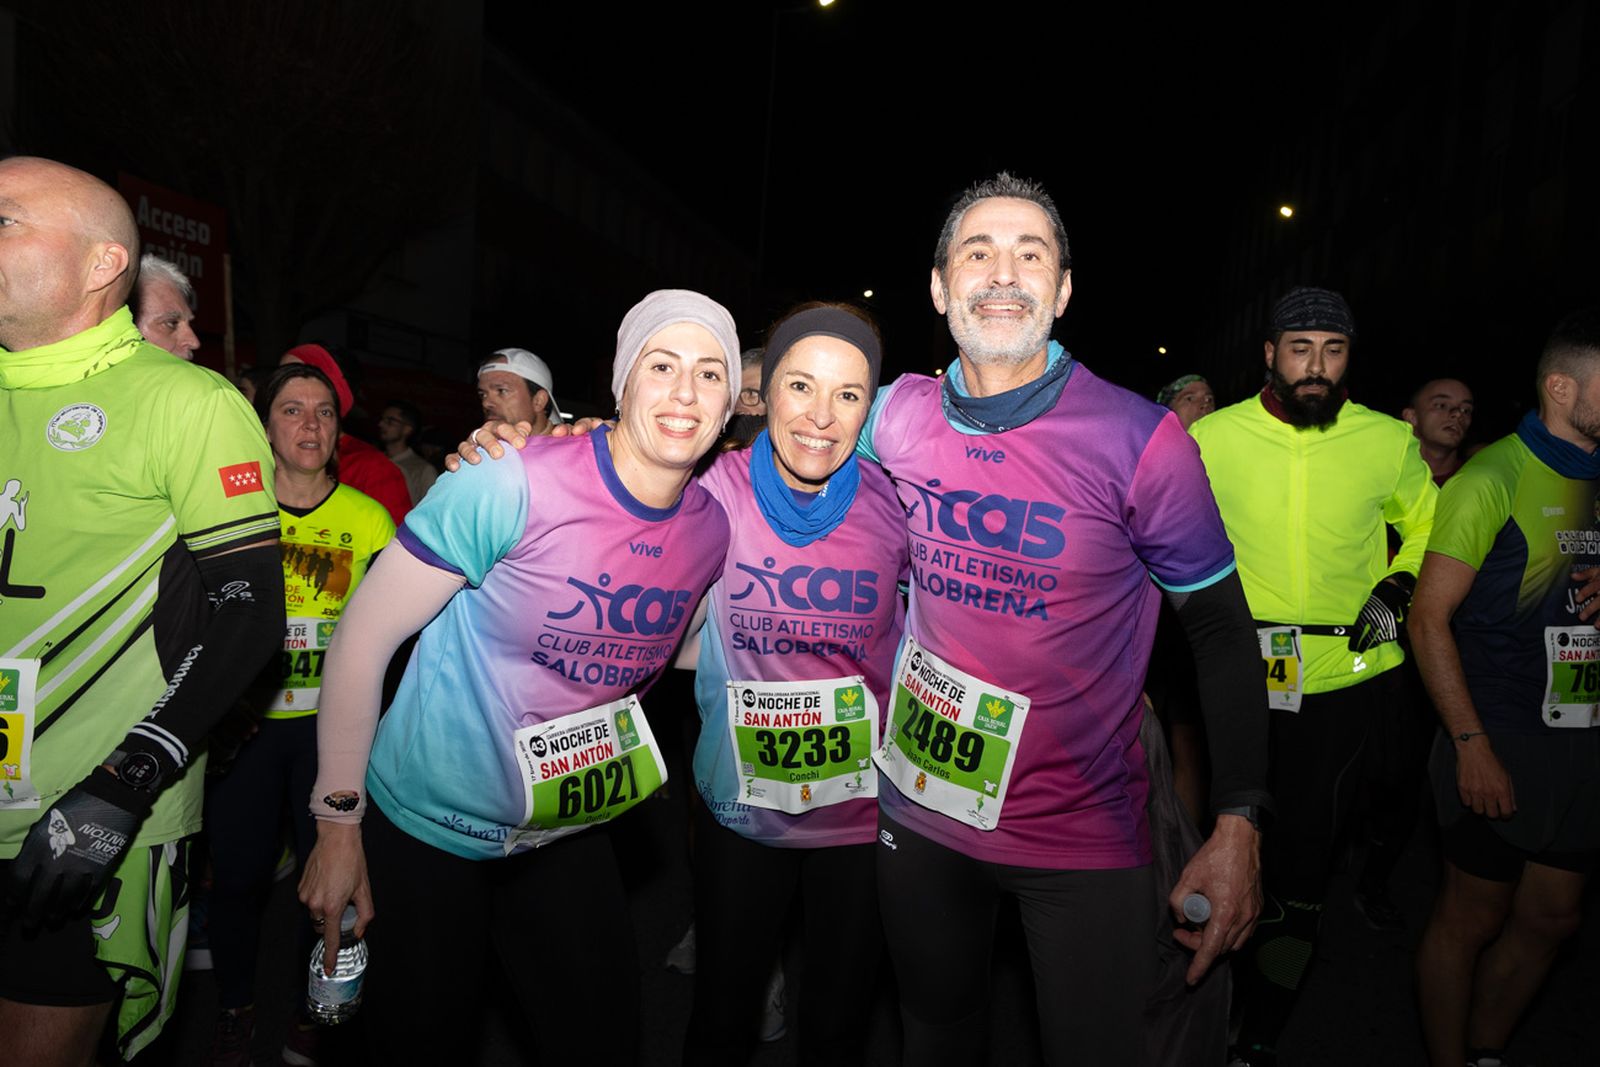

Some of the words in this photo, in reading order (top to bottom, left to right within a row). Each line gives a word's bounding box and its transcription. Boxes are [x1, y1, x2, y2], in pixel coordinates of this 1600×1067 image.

[138, 195, 210, 245] Acceso
[965, 446, 1006, 463] vive
[628, 541, 663, 558] vive
[910, 541, 928, 562] UB
[931, 548, 1057, 592] ATLETISMO
[911, 562, 1049, 621] ALOBREÑA
[295, 627, 308, 637] DE
[730, 613, 773, 631] CLUB
[778, 620, 874, 639] ATLETISMO
[537, 633, 591, 657] CLUB
[592, 641, 672, 663] ATLETISMO
[732, 632, 867, 662] SALOBREÑA
[1559, 650, 1582, 661] SAN
[918, 665, 949, 694] NOCHE
[949, 687, 966, 704] DE
[1570, 663, 1600, 692] 76
[758, 697, 801, 710] NOCHE
[804, 696, 820, 708] DE
[904, 674, 924, 698] SAN
[920, 688, 961, 722] ANTÓN
[744, 712, 770, 727] SAN
[773, 709, 822, 727] ANTÓN
[550, 729, 593, 755] NOCHE
[595, 724, 609, 740] DE
[755, 726, 851, 769] 3233
[901, 698, 985, 773] 2489
[540, 756, 570, 780] SAN
[573, 741, 614, 771] ANTÓN
[922, 760, 951, 779] Carlos
[558, 755, 639, 820] 6021
[789, 770, 819, 782] Conchi
[78, 823, 127, 847] ANTÓN
[91, 838, 122, 857] SAN
